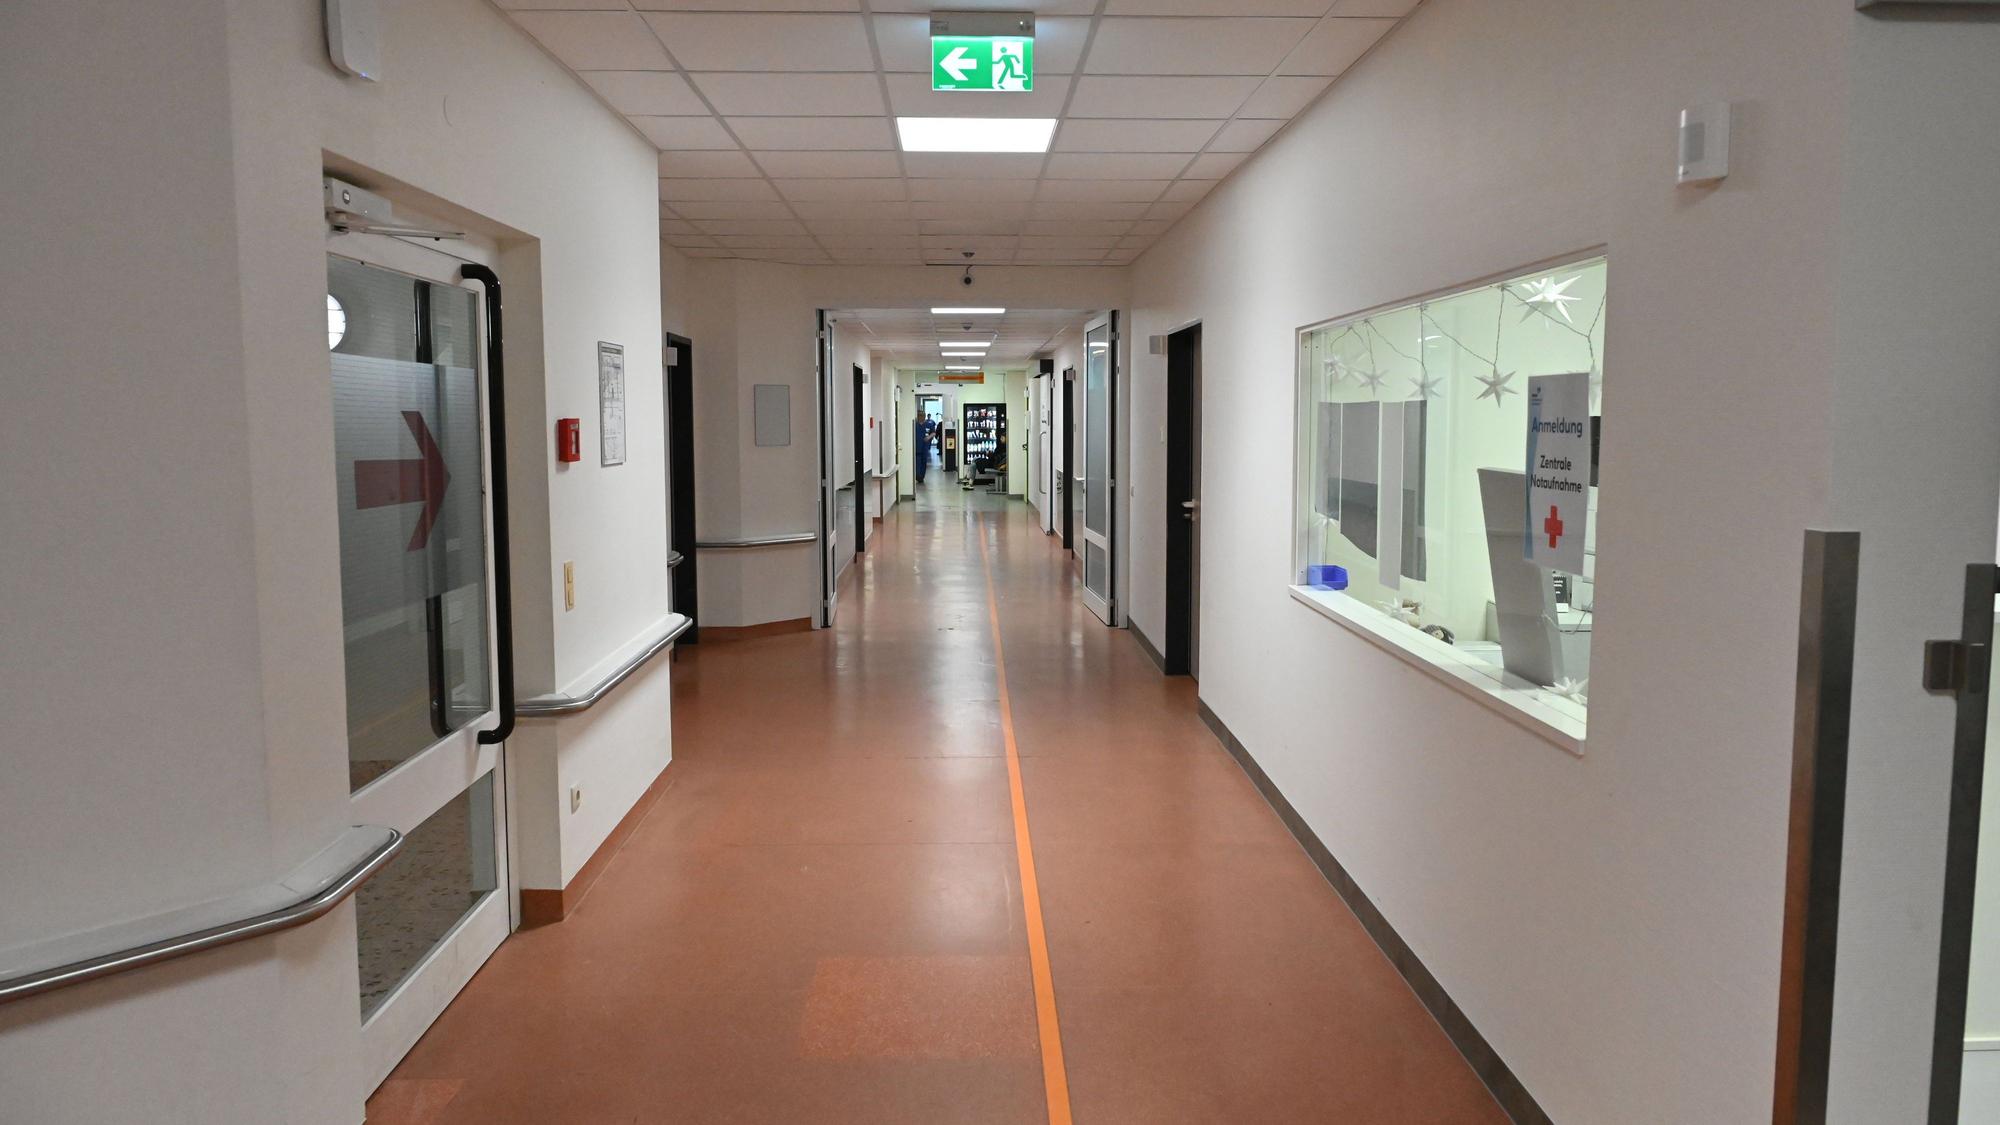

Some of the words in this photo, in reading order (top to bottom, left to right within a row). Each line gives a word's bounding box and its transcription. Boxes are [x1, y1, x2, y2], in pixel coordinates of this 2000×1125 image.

[1531, 416, 1583, 438] Anmeldung
[1540, 455, 1572, 471] Zentrale
[1530, 474, 1582, 493] Notaufnahme
